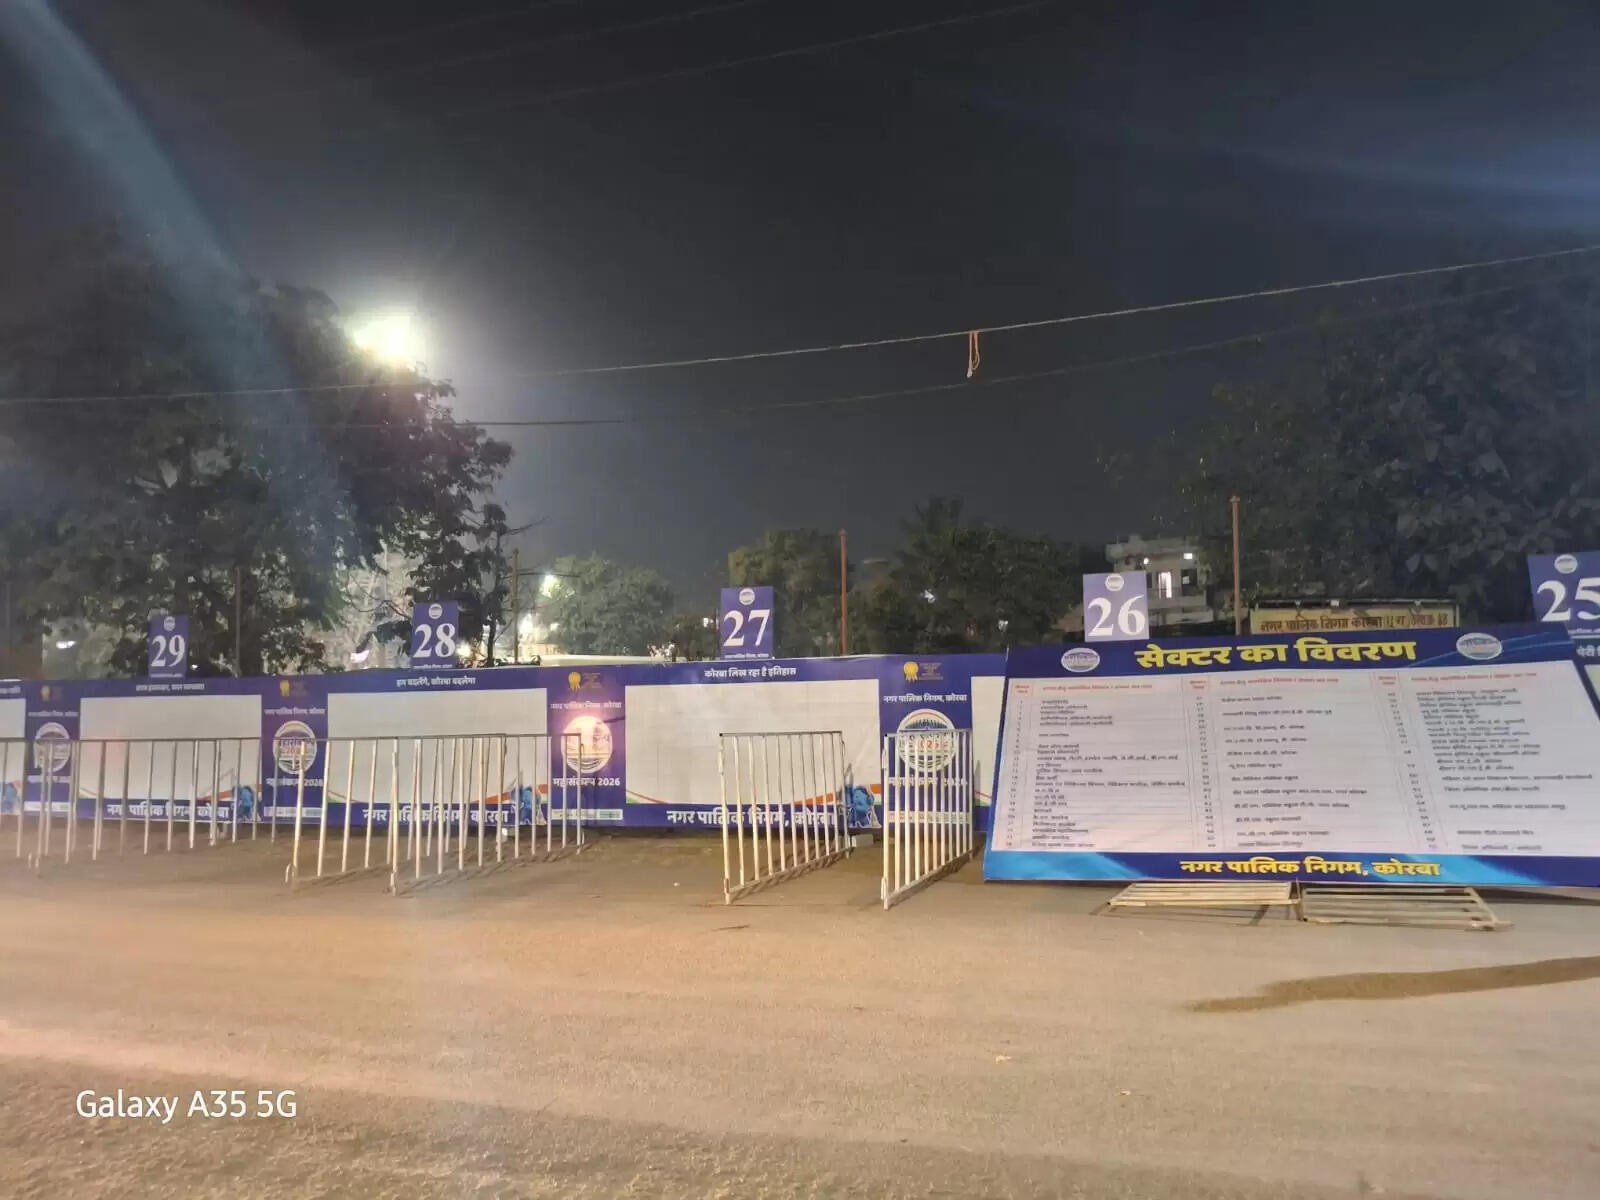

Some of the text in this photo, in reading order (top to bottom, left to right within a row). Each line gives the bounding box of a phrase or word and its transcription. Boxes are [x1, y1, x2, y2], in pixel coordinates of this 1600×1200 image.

[1537, 577, 1600, 621] 25
[723, 609, 770, 647] 27
[1087, 594, 1146, 637] 26
[151, 635, 185, 667] 29
[413, 623, 456, 658] 28
[1134, 637, 1416, 668] सेक्टर का विवरण
[598, 778, 621, 787] 2026
[666, 810, 694, 824] नगर
[1180, 856, 1441, 876] नगर पालिक निगम, कोरबा
